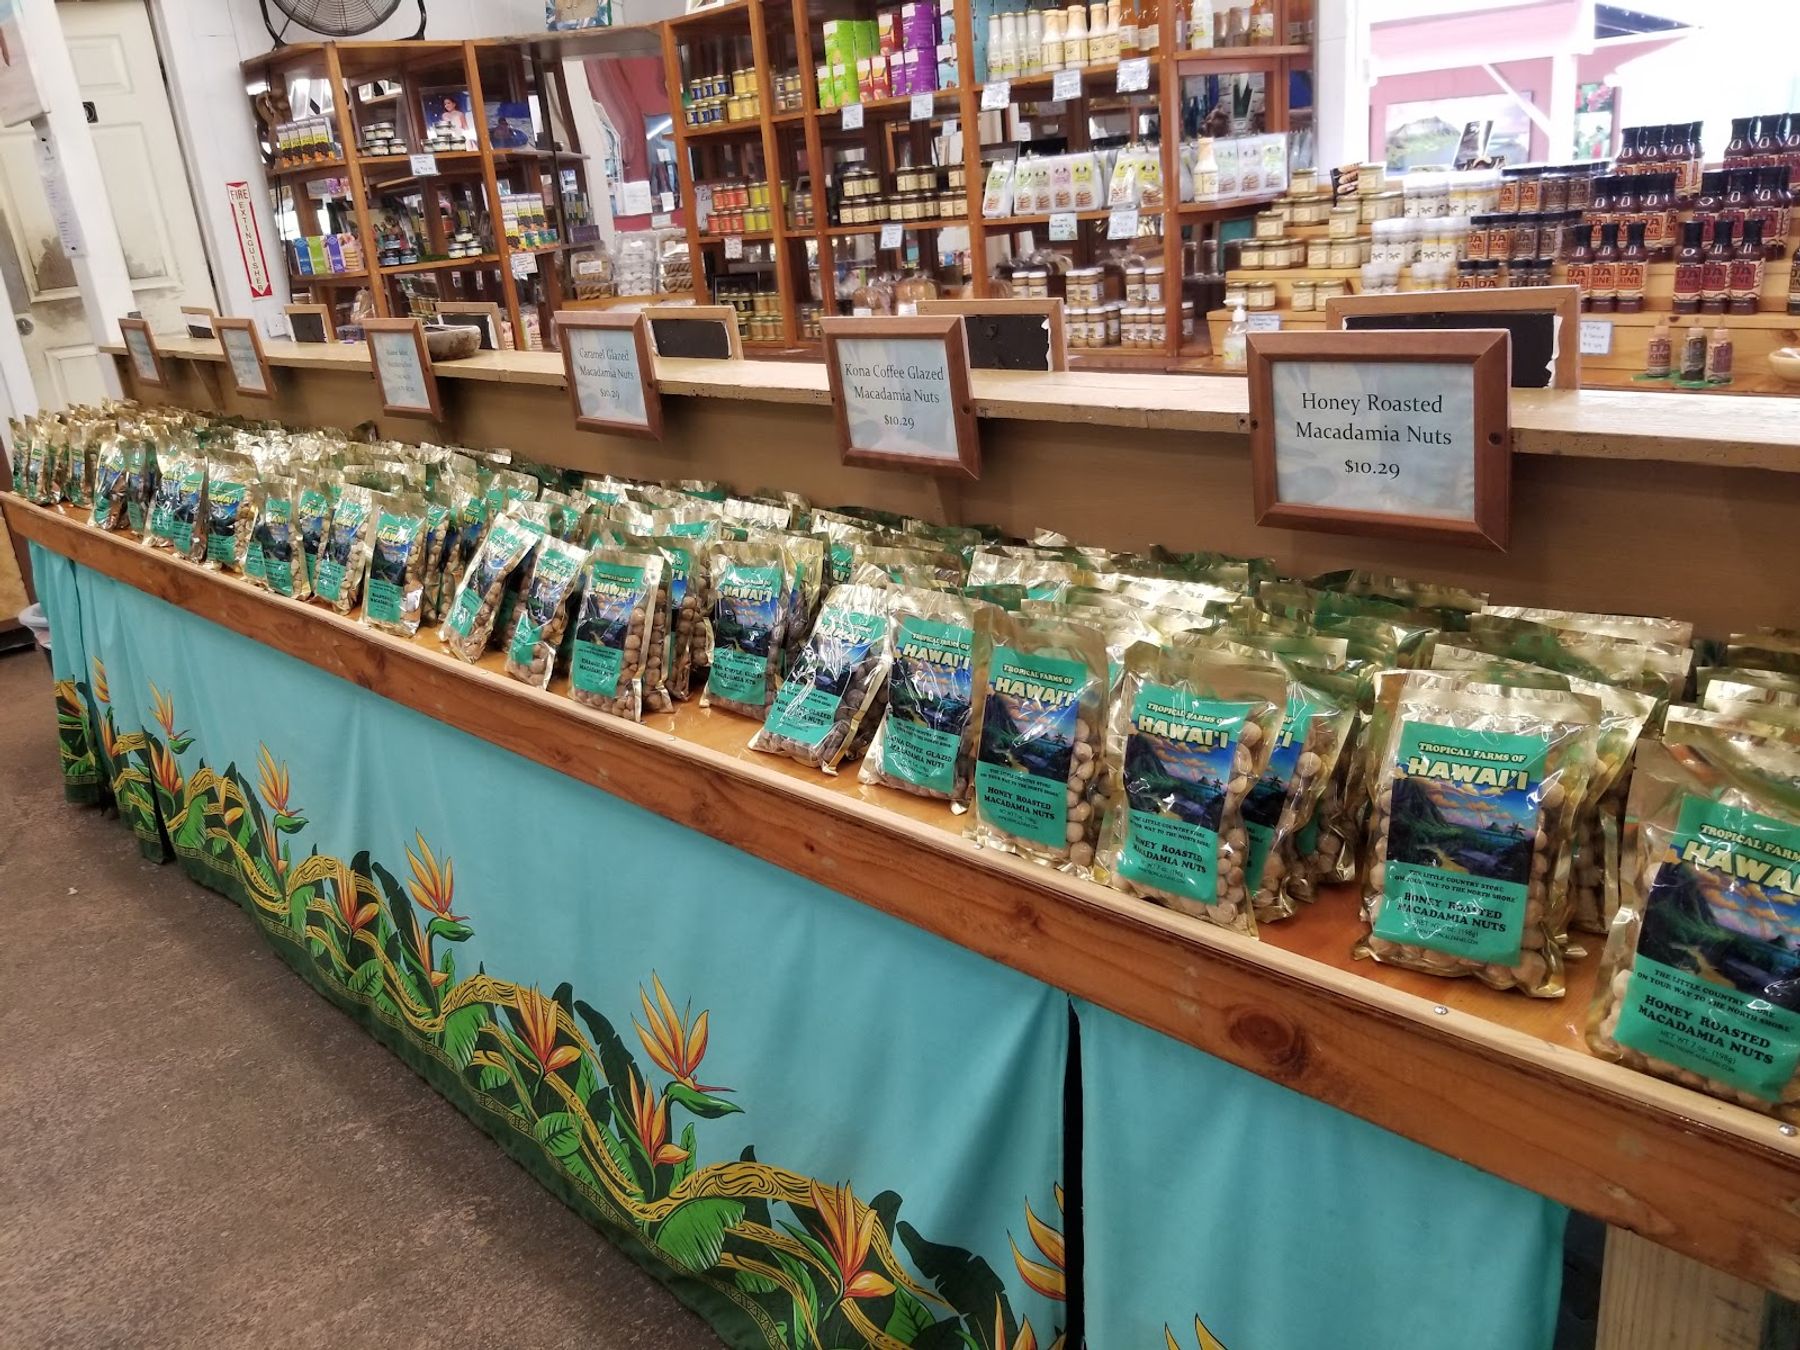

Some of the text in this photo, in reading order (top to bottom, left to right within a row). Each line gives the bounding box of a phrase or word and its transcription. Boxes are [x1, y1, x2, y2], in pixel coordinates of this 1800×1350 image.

[230, 190, 249, 200] FIRE
[239, 202, 263, 290] EXTINGUISHER
[1567, 269, 1586, 277] DA
[1592, 268, 1612, 276] DA
[1620, 267, 1641, 276] DA
[1478, 280, 1497, 288] DA
[580, 348, 629, 360] Caramel Glazed
[580, 366, 634, 379] Macadamia Nuts
[844, 363, 944, 381] Kona Coffee Glazed
[854, 386, 940, 403] Macadamia Nuts
[1302, 392, 1443, 415] Honey Roasted
[884, 415, 915, 429] $10.29
[1296, 421, 1452, 446] Macadamia Nuts
[1345, 459, 1401, 480] $10.29
[902, 643, 971, 671] HAWAI'I
[1003, 663, 1075, 686] TROPICAL FARMS OF
[1147, 701, 1185, 717] TROPICAL
[1186, 712, 1216, 724] FARMS
[1138, 714, 1230, 750] HAWAI'I
[925, 758, 945, 769] NUTS
[1418, 741, 1528, 764] TROPICAL FARMS OF
[1407, 756, 1529, 791] HAWAI'I
[984, 794, 1031, 814] MACADAMIA
[1032, 809, 1056, 820] NUTS
[987, 786, 1052, 811] HONEY ROASTED
[1135, 835, 1203, 863] NEY ROASTED
[1700, 823, 1800, 862] TROPICAL FARM
[1181, 860, 1207, 874] NUTS
[1682, 840, 1800, 897] HAWA
[1423, 872, 1444, 881] LITTLE
[1446, 876, 1479, 889] COUNTRY
[1481, 883, 1505, 893] STORE
[1425, 880, 1439, 888] WAY
[1452, 885, 1467, 894] THE
[1467, 888, 1491, 899] NORTH
[1397, 902, 1507, 932] MACADAMIA NUTS
[1404, 891, 1503, 920] HONEY ROASTED
[1637, 972, 1648, 981] ON
[1650, 976, 1672, 989] YOUR
[1674, 986, 1693, 998] WAY
[1694, 993, 1706, 1002] TO
[1708, 998, 1727, 1010] THE
[1728, 1005, 1759, 1023] NORTH
[1655, 969, 1671, 980] THE
[1672, 974, 1701, 992] LITTLE
[1702, 987, 1746, 1006] COUNTRY
[1644, 994, 1771, 1049] HONEY ROASTED
[1638, 1004, 1775, 1065] MACADAMIA NUTS
[1660, 1030, 1675, 1041] NET
